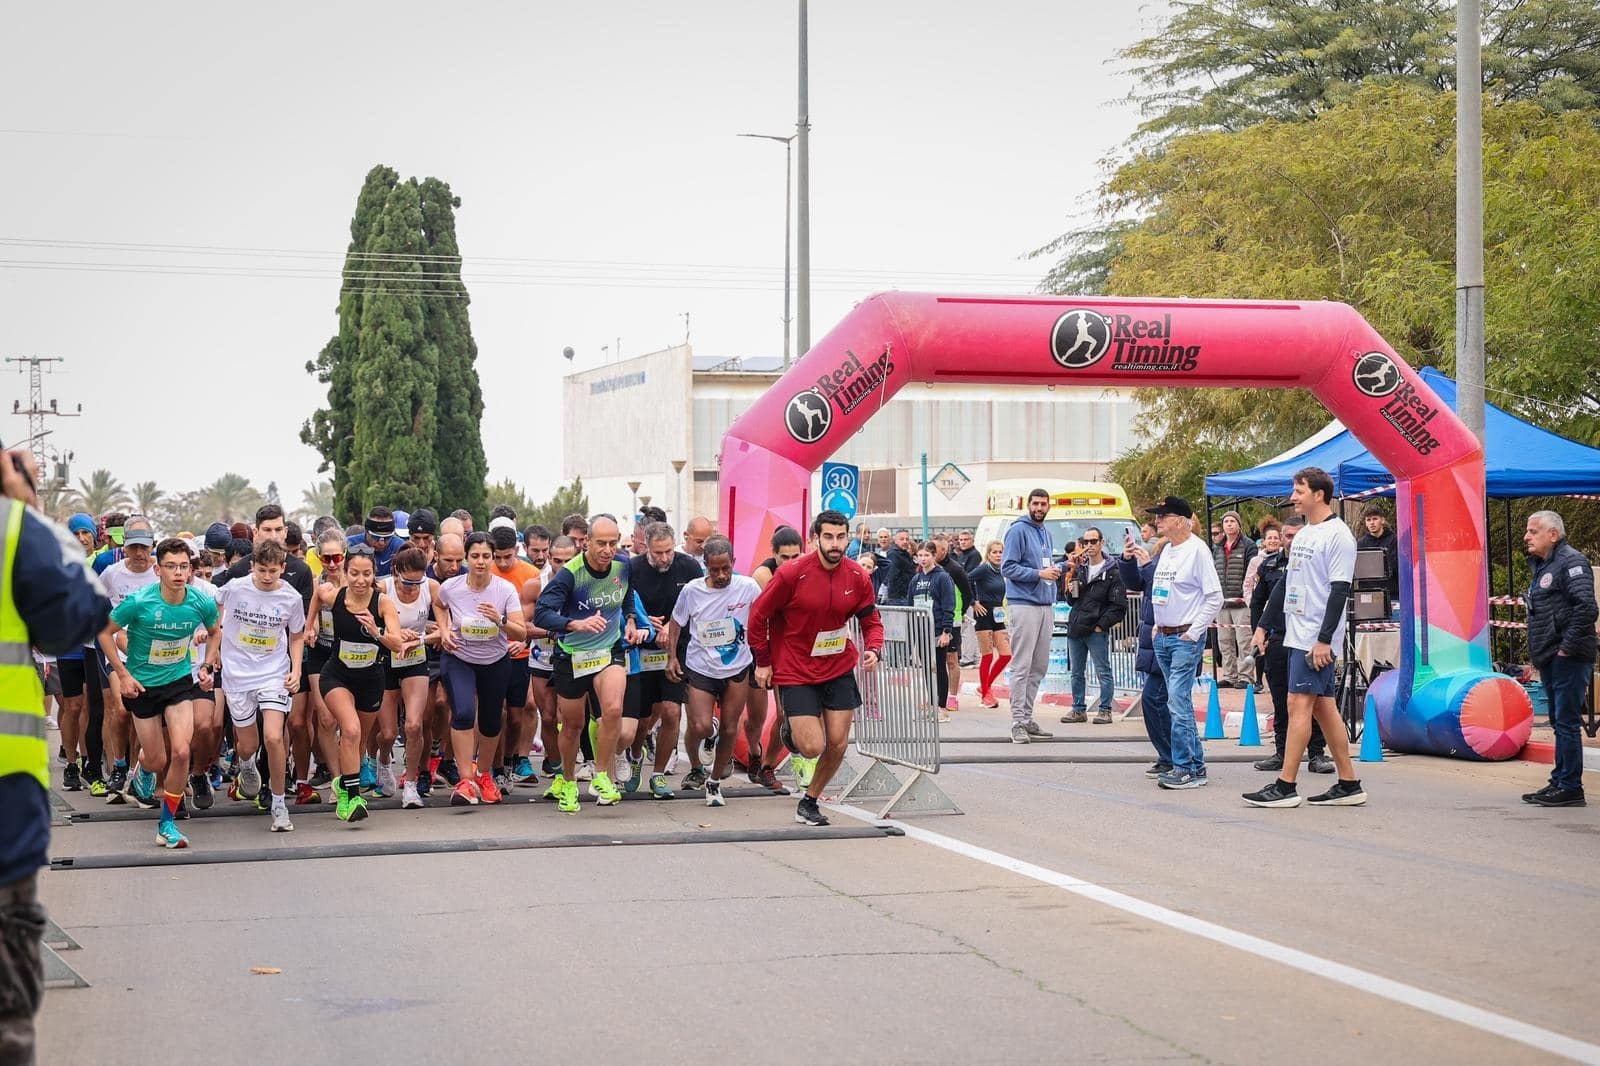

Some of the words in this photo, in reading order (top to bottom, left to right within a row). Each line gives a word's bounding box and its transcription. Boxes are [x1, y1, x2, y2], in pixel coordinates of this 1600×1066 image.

[1114, 313, 1171, 338] Real
[1113, 338, 1202, 371] Timing
[1113, 363, 1177, 371] realtiming.co.il
[817, 349, 862, 396] Real
[828, 351, 894, 411] Timing
[1398, 382, 1439, 423] Real
[1384, 391, 1440, 455] Timing
[830, 473, 851, 488] 30
[153, 621, 193, 630] MULTI
